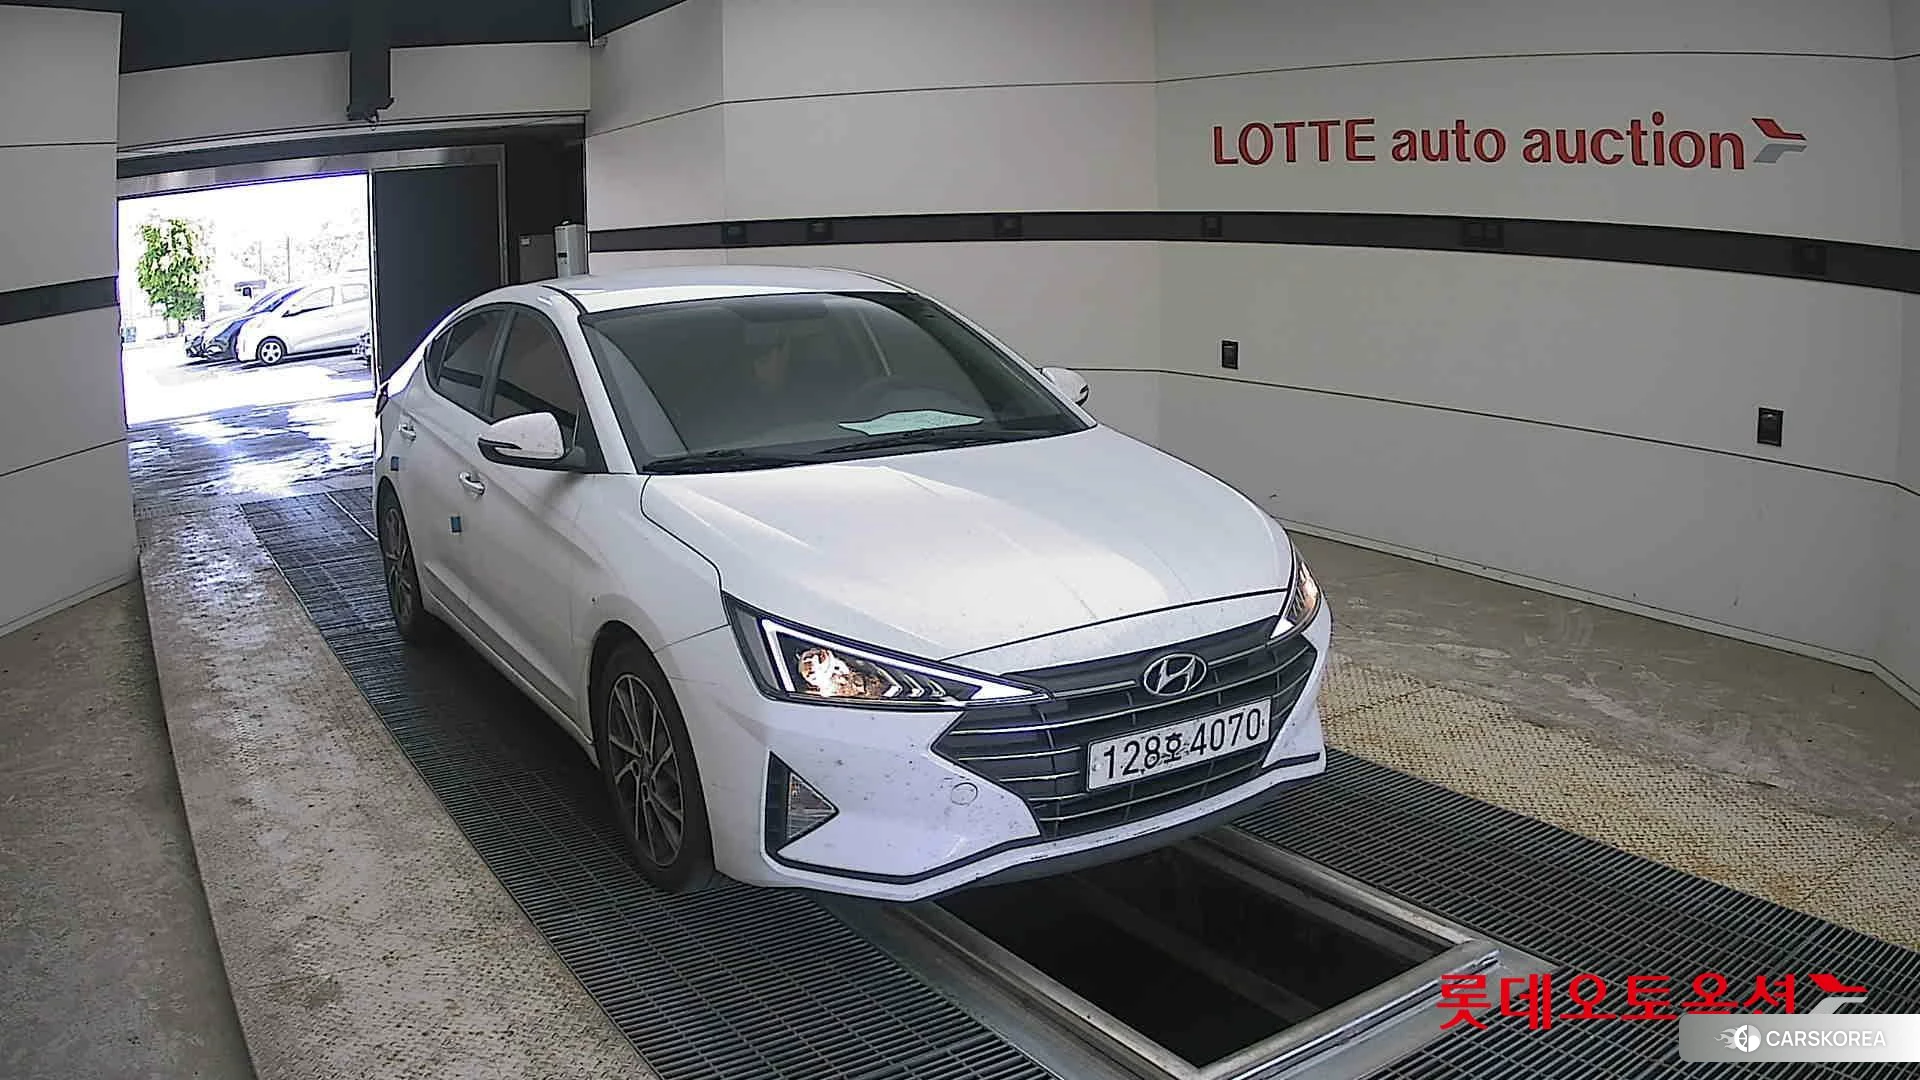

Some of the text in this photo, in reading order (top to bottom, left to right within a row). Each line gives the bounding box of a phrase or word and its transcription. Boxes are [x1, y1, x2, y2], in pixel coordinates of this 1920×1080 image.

[1212, 111, 1746, 171] LOTTE auto auction
